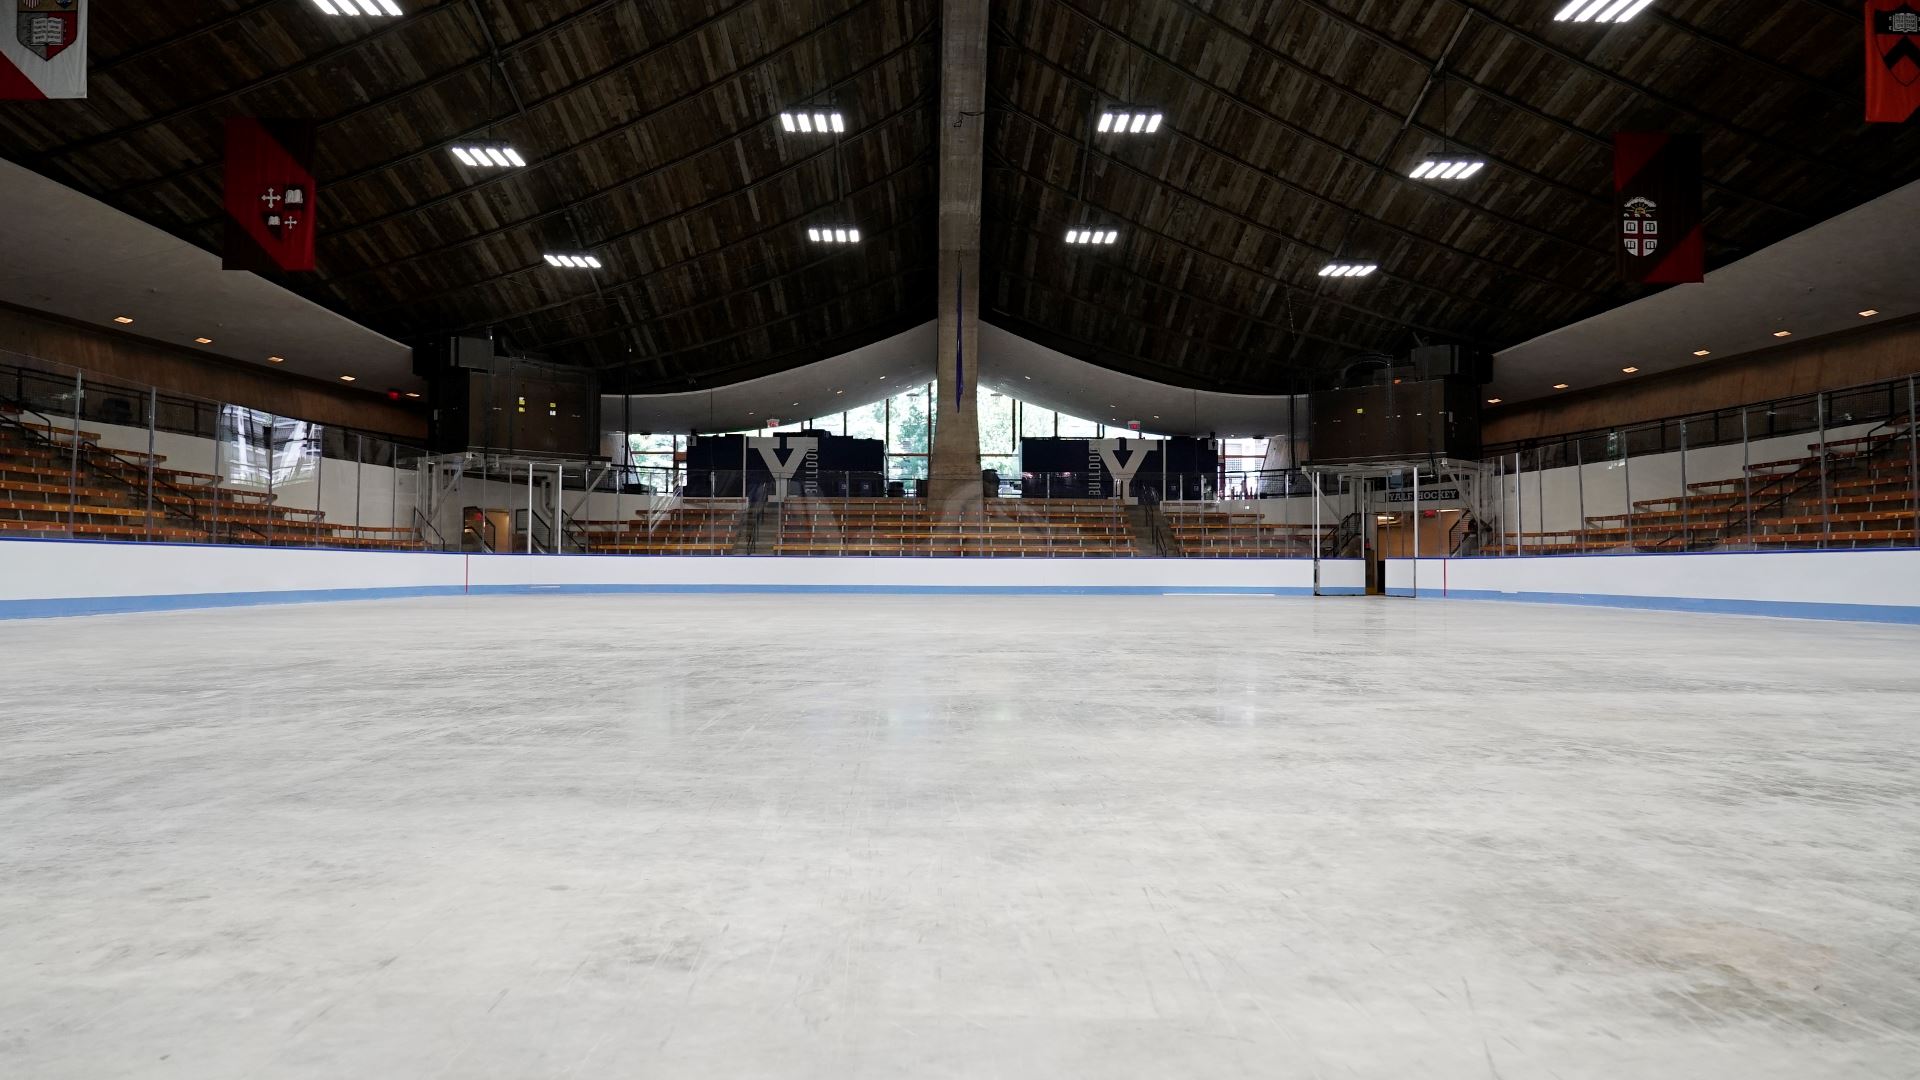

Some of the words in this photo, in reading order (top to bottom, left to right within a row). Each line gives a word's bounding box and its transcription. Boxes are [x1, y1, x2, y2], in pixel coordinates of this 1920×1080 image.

[749, 437, 818, 503] Y
[1089, 439, 1158, 505] Y
[1417, 490, 1457, 500] HOCKEY
